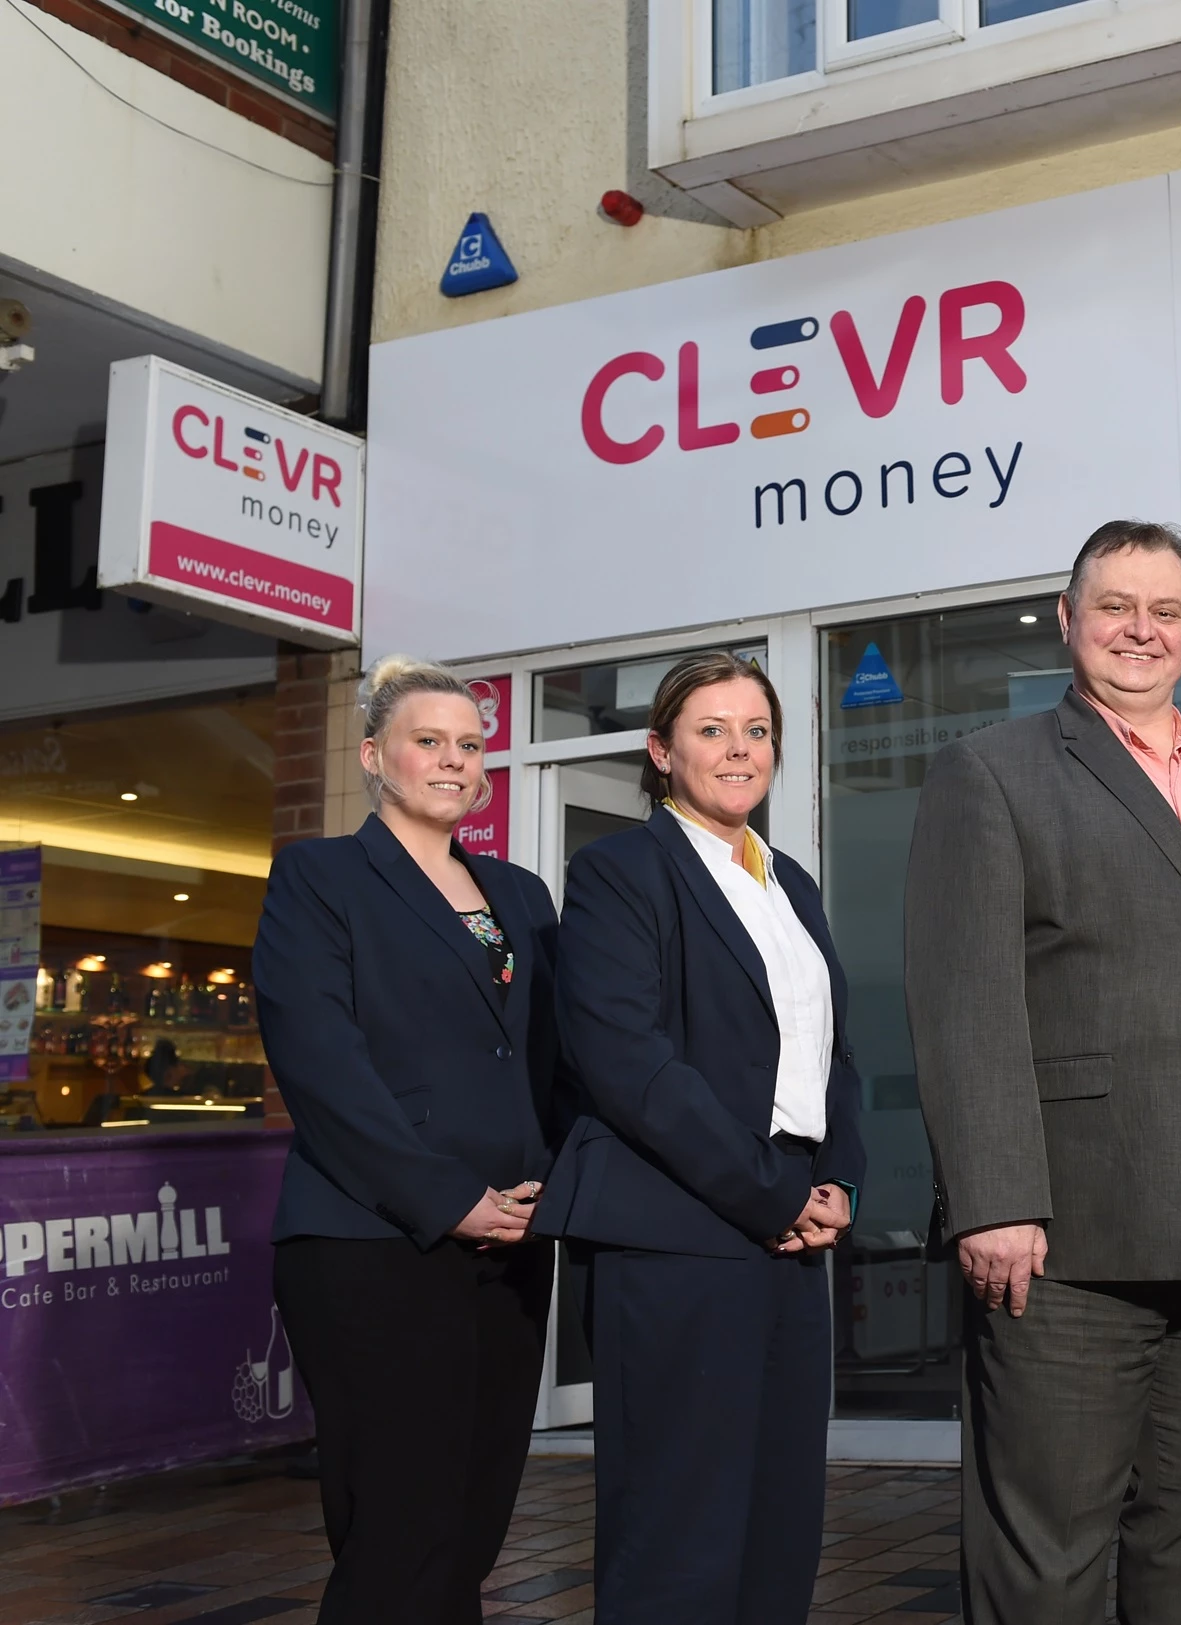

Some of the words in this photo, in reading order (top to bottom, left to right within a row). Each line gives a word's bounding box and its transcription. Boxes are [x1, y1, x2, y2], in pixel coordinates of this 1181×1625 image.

[233, 1, 297, 51] ROOM
[271, 0, 321, 30] enus
[201, 12, 315, 93] Bookings
[449, 256, 491, 276] Chubb
[581, 280, 1027, 465] CLEVR
[172, 404, 342, 508] CLEVR
[755, 441, 1023, 529] money
[242, 495, 339, 549] money
[177, 555, 332, 616] www.clevr.money
[840, 727, 949, 756] responsible
[459, 823, 494, 844] Find
[2, 1284, 53, 1309] Cafe
[64, 1282, 97, 1302] Bar
[107, 1276, 120, 1297] &
[130, 1266, 230, 1293] Restaurant
